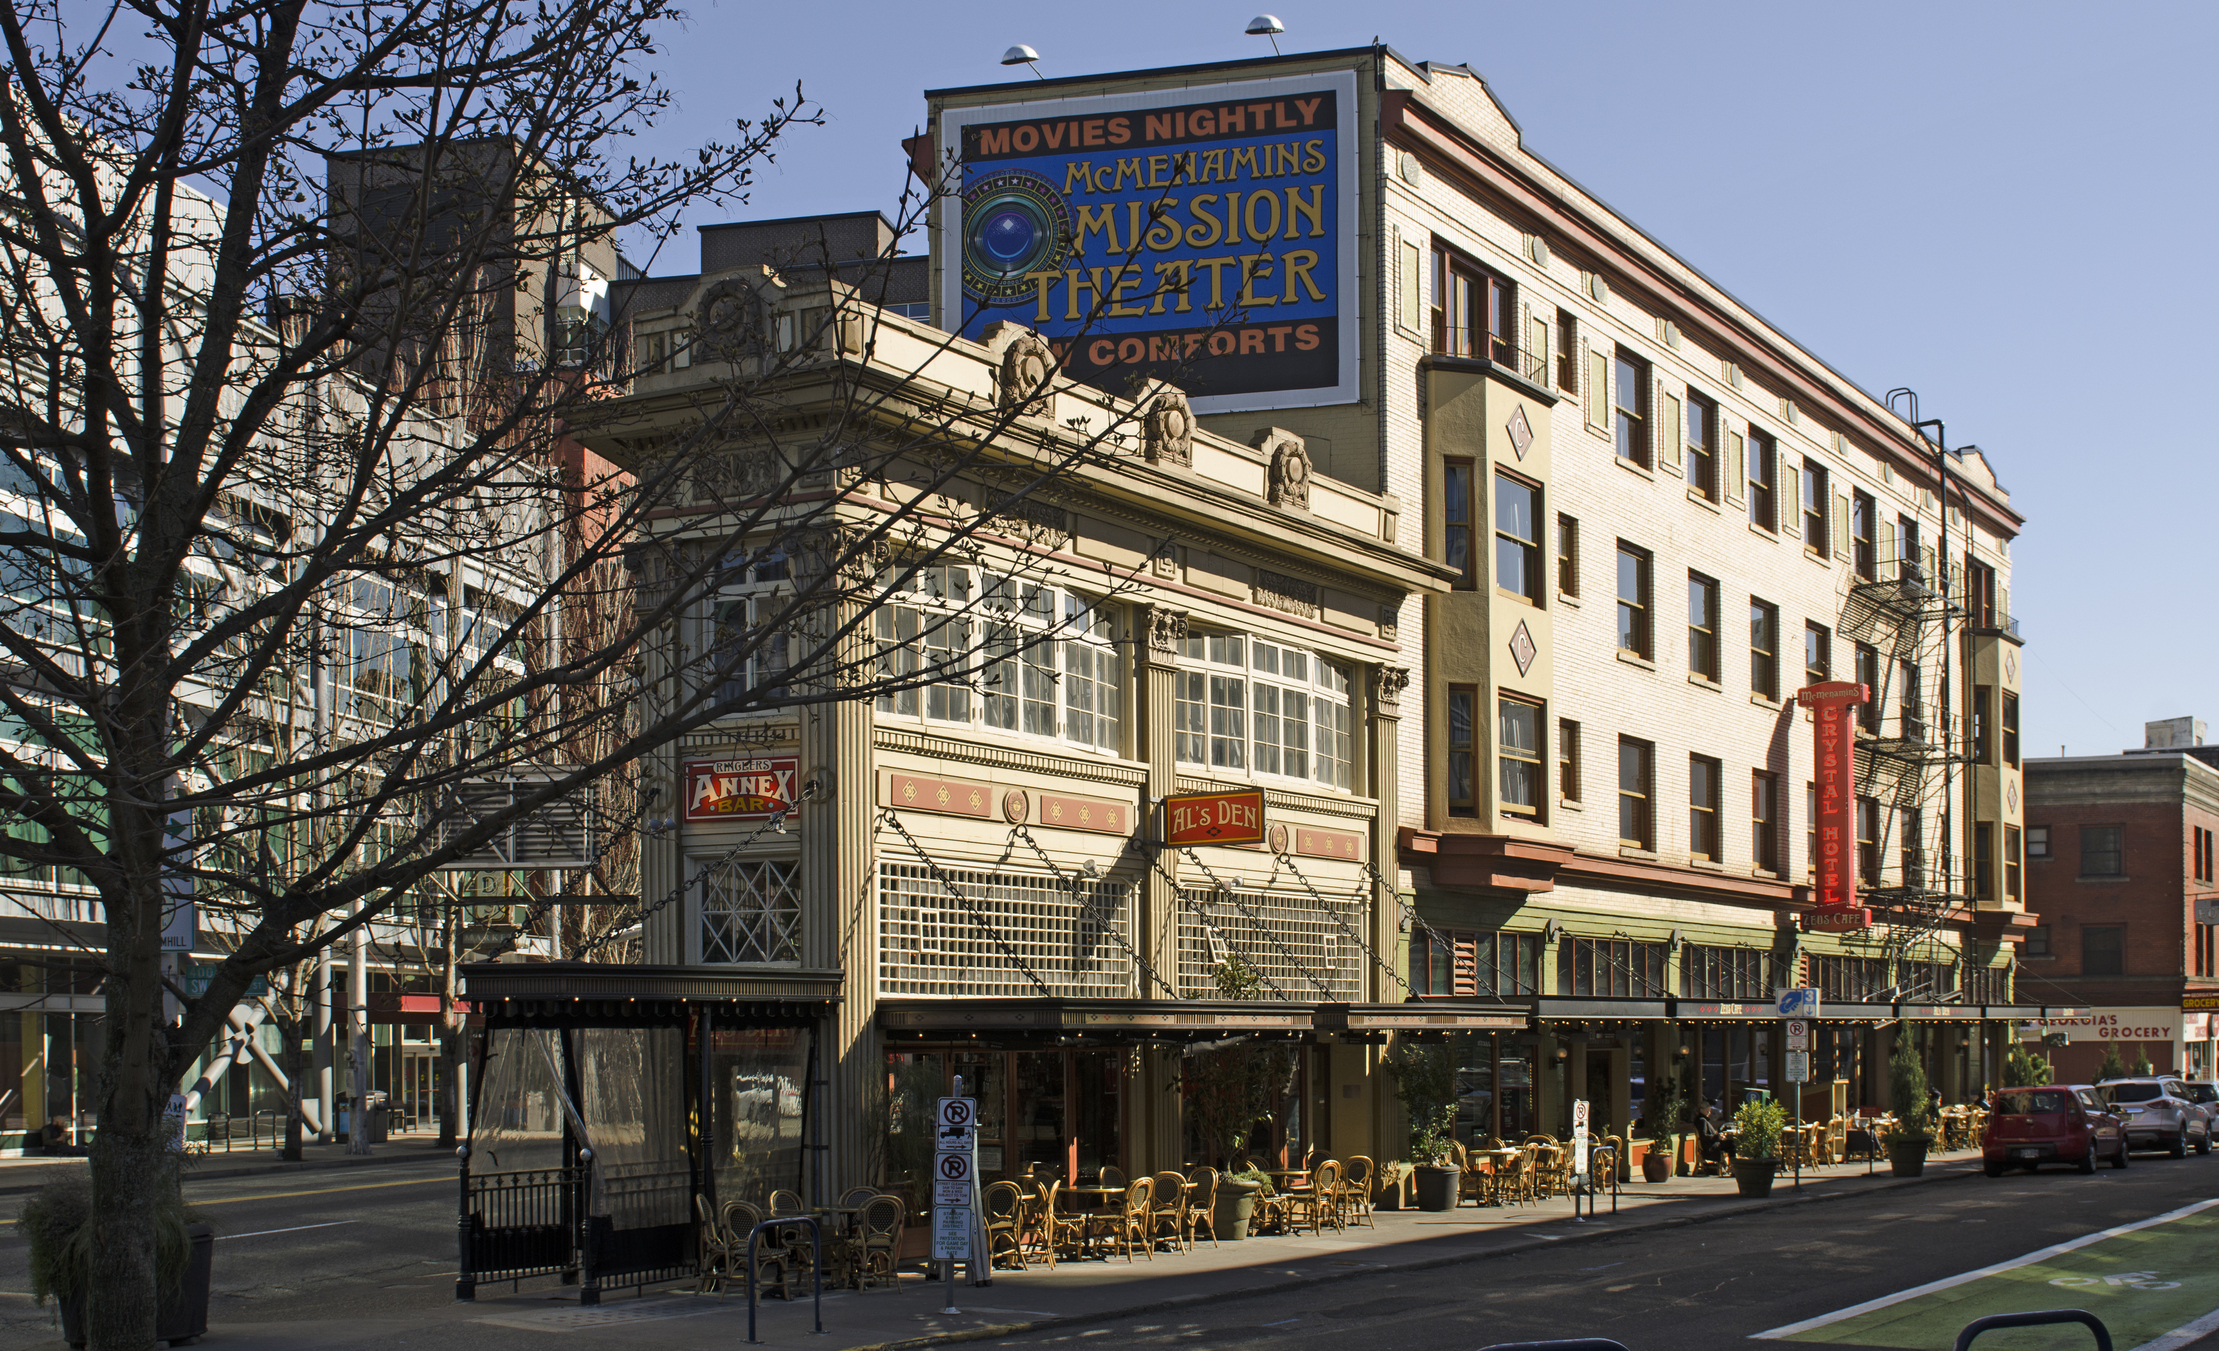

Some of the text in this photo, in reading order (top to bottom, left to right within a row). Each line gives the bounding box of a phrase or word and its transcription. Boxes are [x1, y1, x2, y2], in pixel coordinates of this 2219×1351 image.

[980, 97, 1322, 155] MOVIES NIGHTLY
[1069, 183, 1327, 257] MISSION
[1023, 249, 1327, 323] THEATER
[1088, 324, 1320, 366] COMFORTS
[716, 760, 770, 773] RINGLERS
[690, 769, 794, 812] ANNEX
[717, 797, 765, 813] BAR
[1821, 705, 1840, 903] CRYSTAL HOTEL
[1217, 800, 1257, 829] DEN
[1802, 912, 1861, 926] ZEUS CAFE
[161, 936, 187, 947] MHILL
[188, 967, 214, 978] 400
[191, 980, 262, 993] SW ST
[1804, 990, 1814, 1002] 3
[2099, 1027, 2171, 1038] GROCERY
